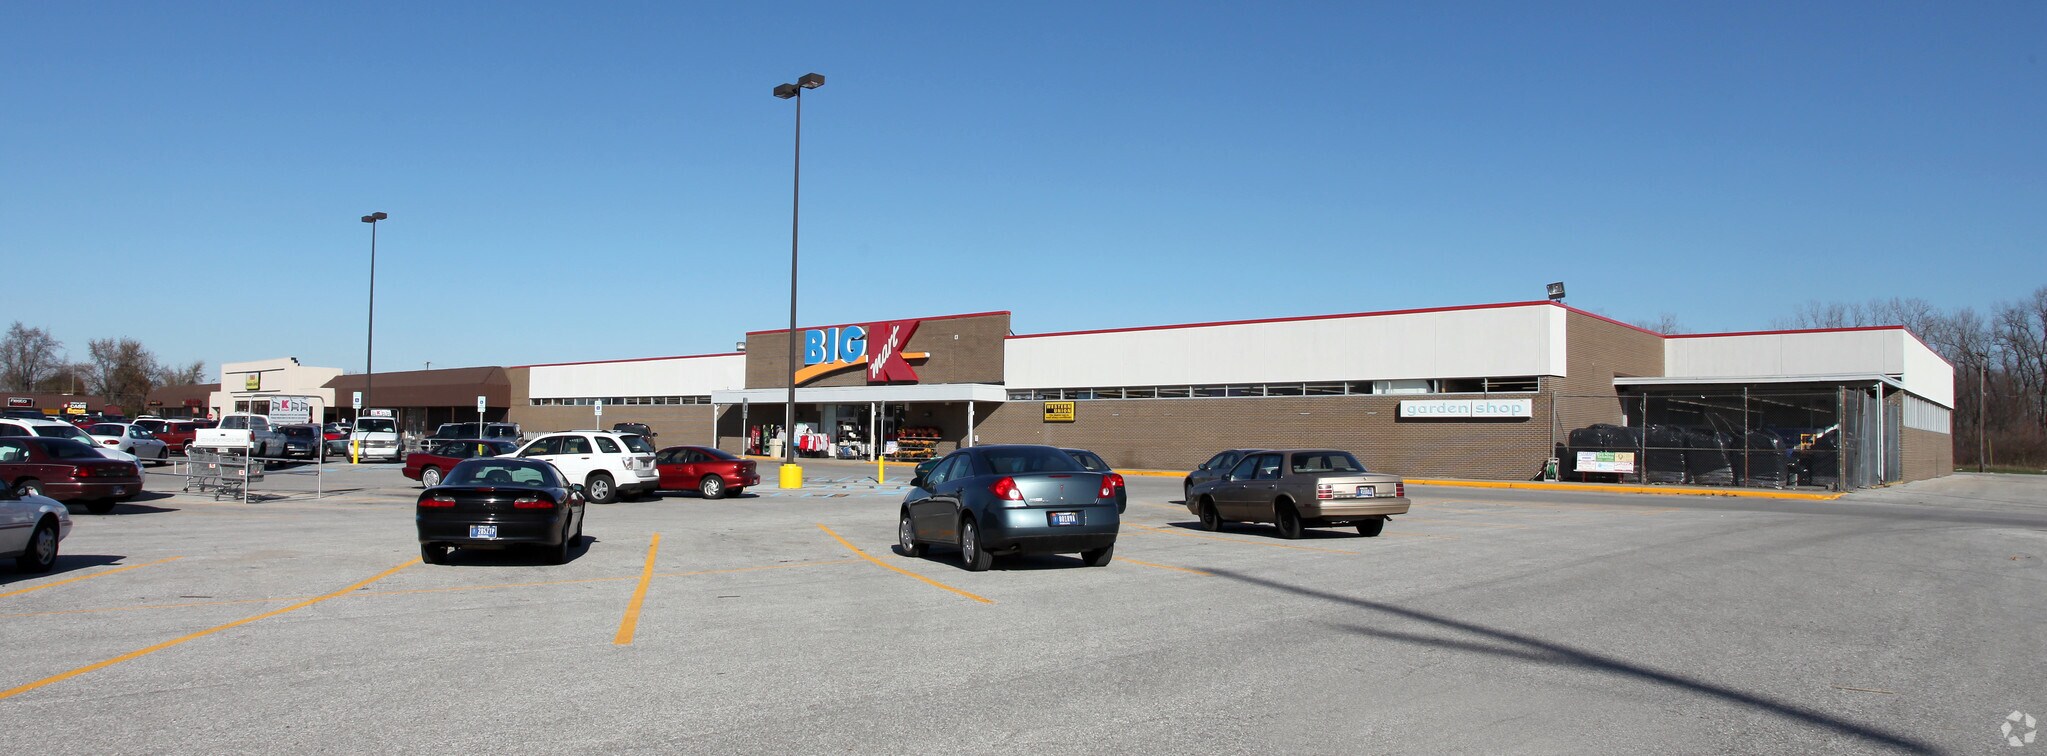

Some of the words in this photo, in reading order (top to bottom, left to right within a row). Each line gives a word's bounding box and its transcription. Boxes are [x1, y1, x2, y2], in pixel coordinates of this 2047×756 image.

[804, 326, 867, 365] BIG
[867, 320, 920, 383] K
[870, 325, 900, 379] mart
[1407, 402, 1469, 417] garden
[1475, 402, 1522, 416] shop
